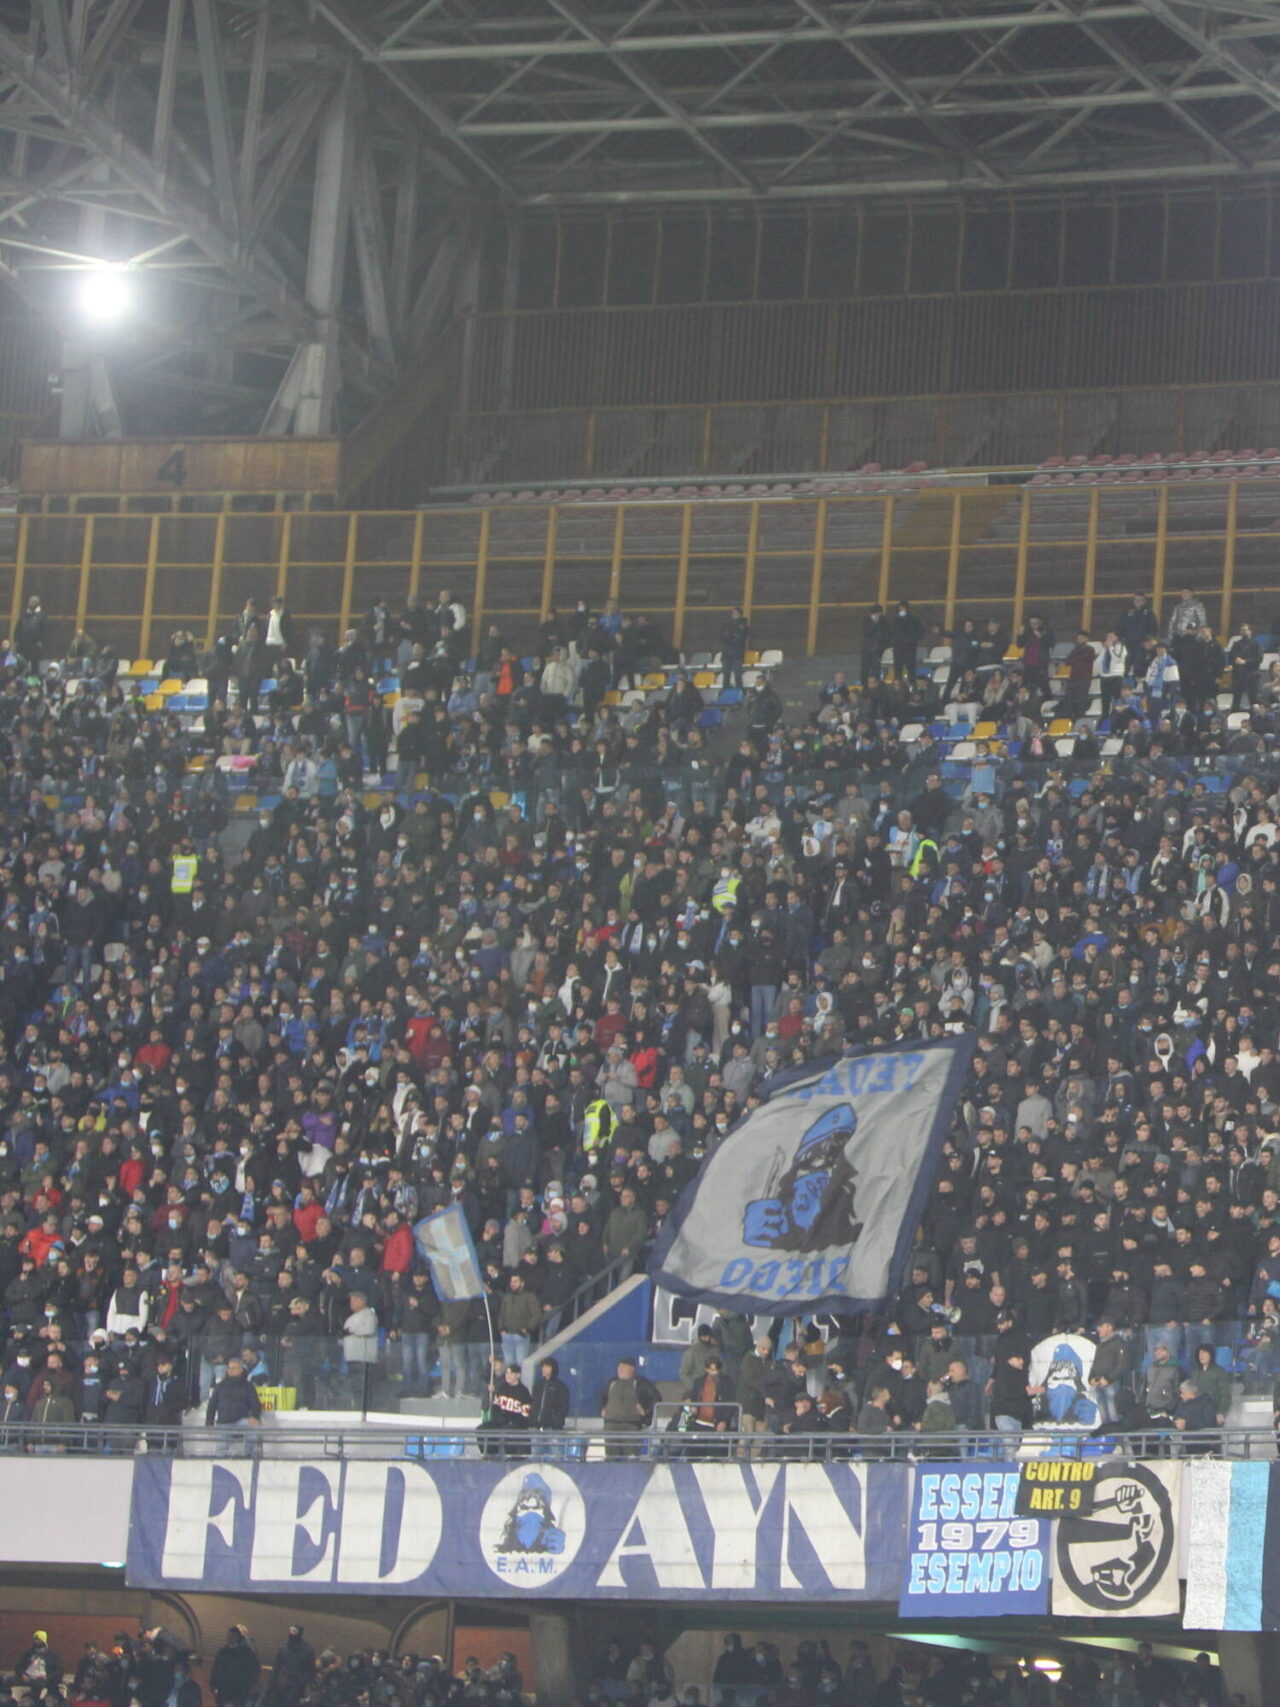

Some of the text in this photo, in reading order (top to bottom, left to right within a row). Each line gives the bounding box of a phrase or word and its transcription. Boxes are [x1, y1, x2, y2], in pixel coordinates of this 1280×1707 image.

[156, 449, 188, 486] 4
[1025, 1462, 1095, 1481] CONTRO
[1029, 1487, 1082, 1510] ART. 9
[918, 1519, 1039, 1551] 1979
[908, 1549, 1043, 1595] ESEMPIO
